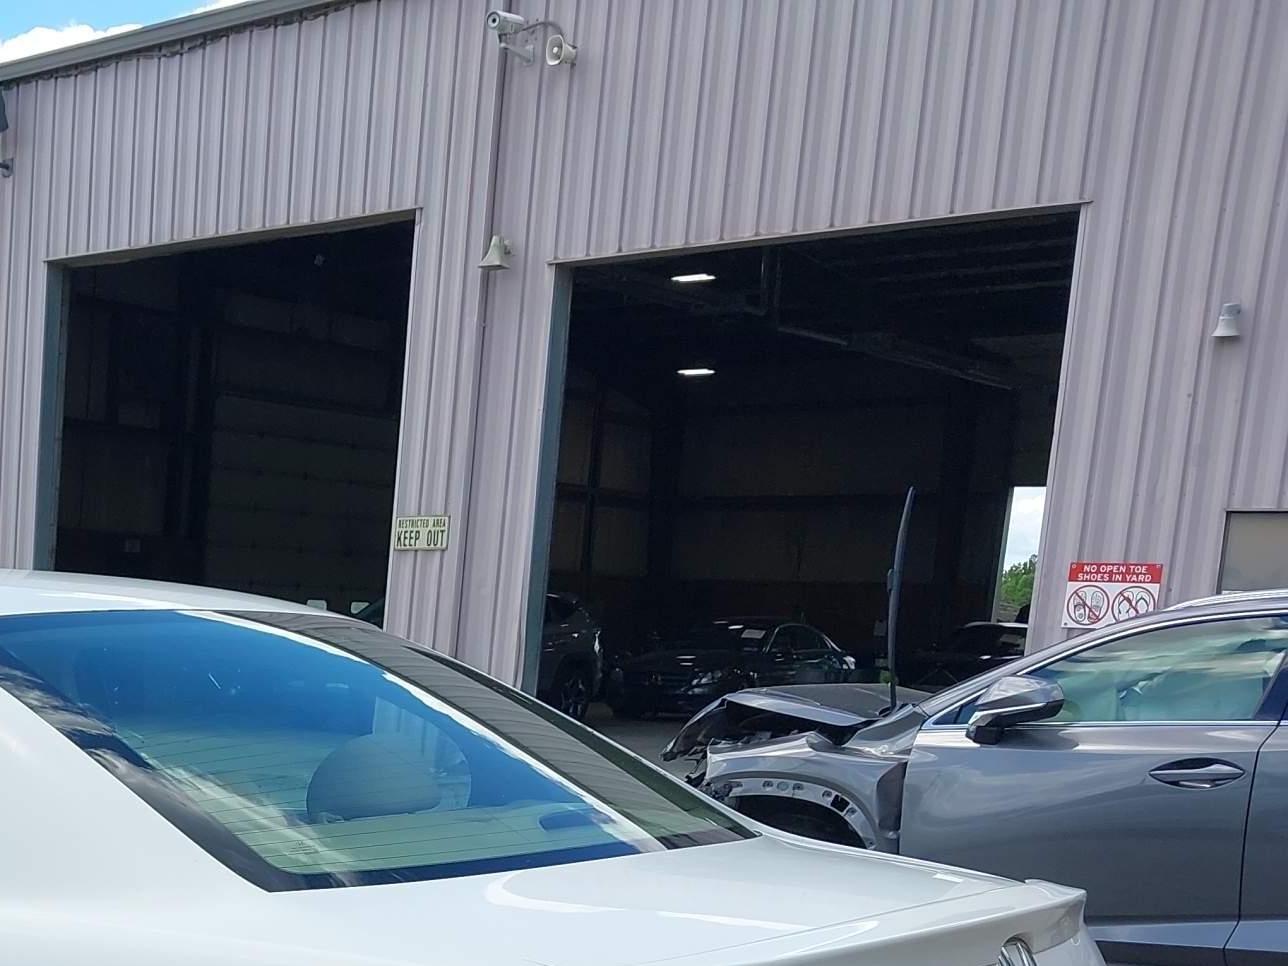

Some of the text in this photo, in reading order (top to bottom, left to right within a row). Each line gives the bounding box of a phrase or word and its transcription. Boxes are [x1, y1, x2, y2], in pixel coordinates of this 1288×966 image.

[398, 519, 445, 528] RESTRICTED AREA
[396, 529, 446, 547] KEEP OUT
[1083, 564, 1149, 574] NO OPEN TOE
[1077, 573, 1152, 582] SHOES IN YARD
